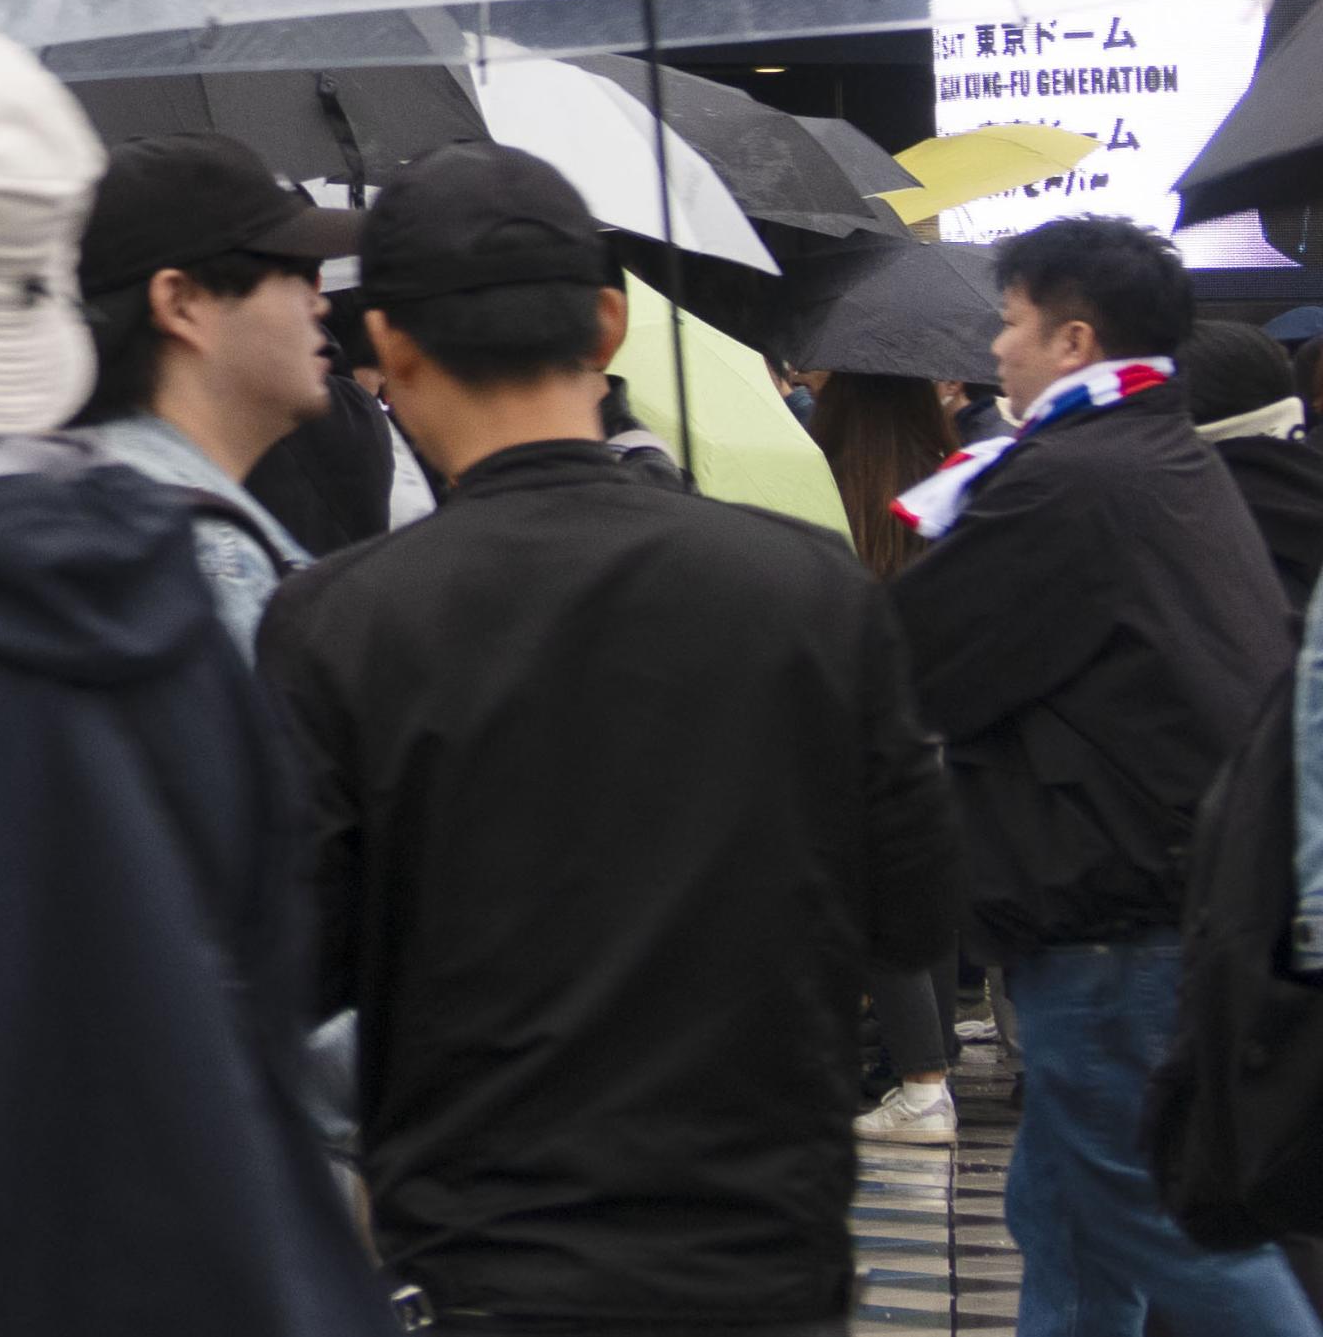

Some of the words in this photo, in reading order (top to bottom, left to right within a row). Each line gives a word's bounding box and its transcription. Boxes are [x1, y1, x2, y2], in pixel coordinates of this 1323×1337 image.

[975, 17, 1137, 58] 東京ドーム
[965, 70, 1030, 99] KUNG-FU
[1037, 65, 1178, 96] GENERATION
